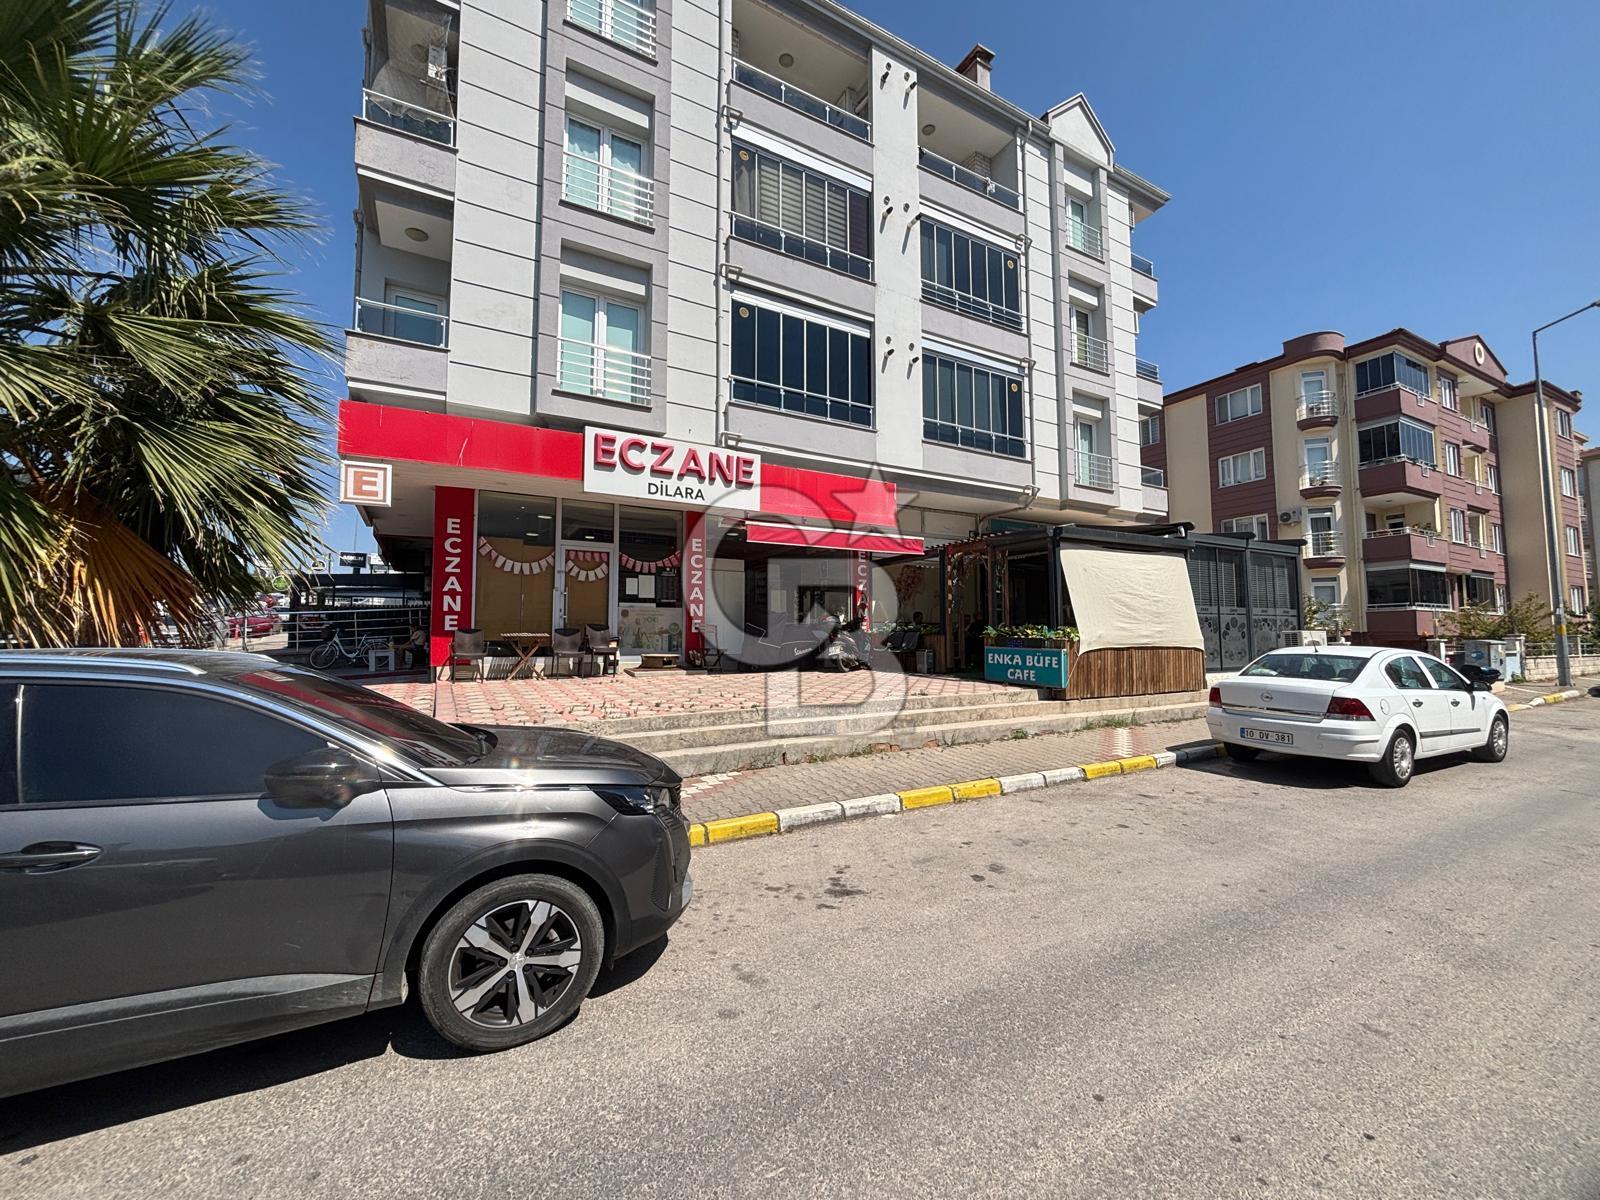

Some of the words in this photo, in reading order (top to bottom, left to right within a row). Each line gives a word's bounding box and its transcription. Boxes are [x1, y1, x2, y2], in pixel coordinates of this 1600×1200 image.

[593, 432, 755, 488] ECZANE
[353, 470, 379, 497] E
[647, 480, 705, 501] DİLARA
[442, 517, 463, 631] ECZANE
[690, 538, 704, 633] ECZANE
[987, 652, 1022, 667] ENKA
[1026, 652, 1059, 669] BÜFE
[1007, 668, 1036, 681] CAFE
[1246, 730, 1254, 738] 10
[1259, 731, 1269, 739] DV
[1275, 733, 1290, 742] 381
